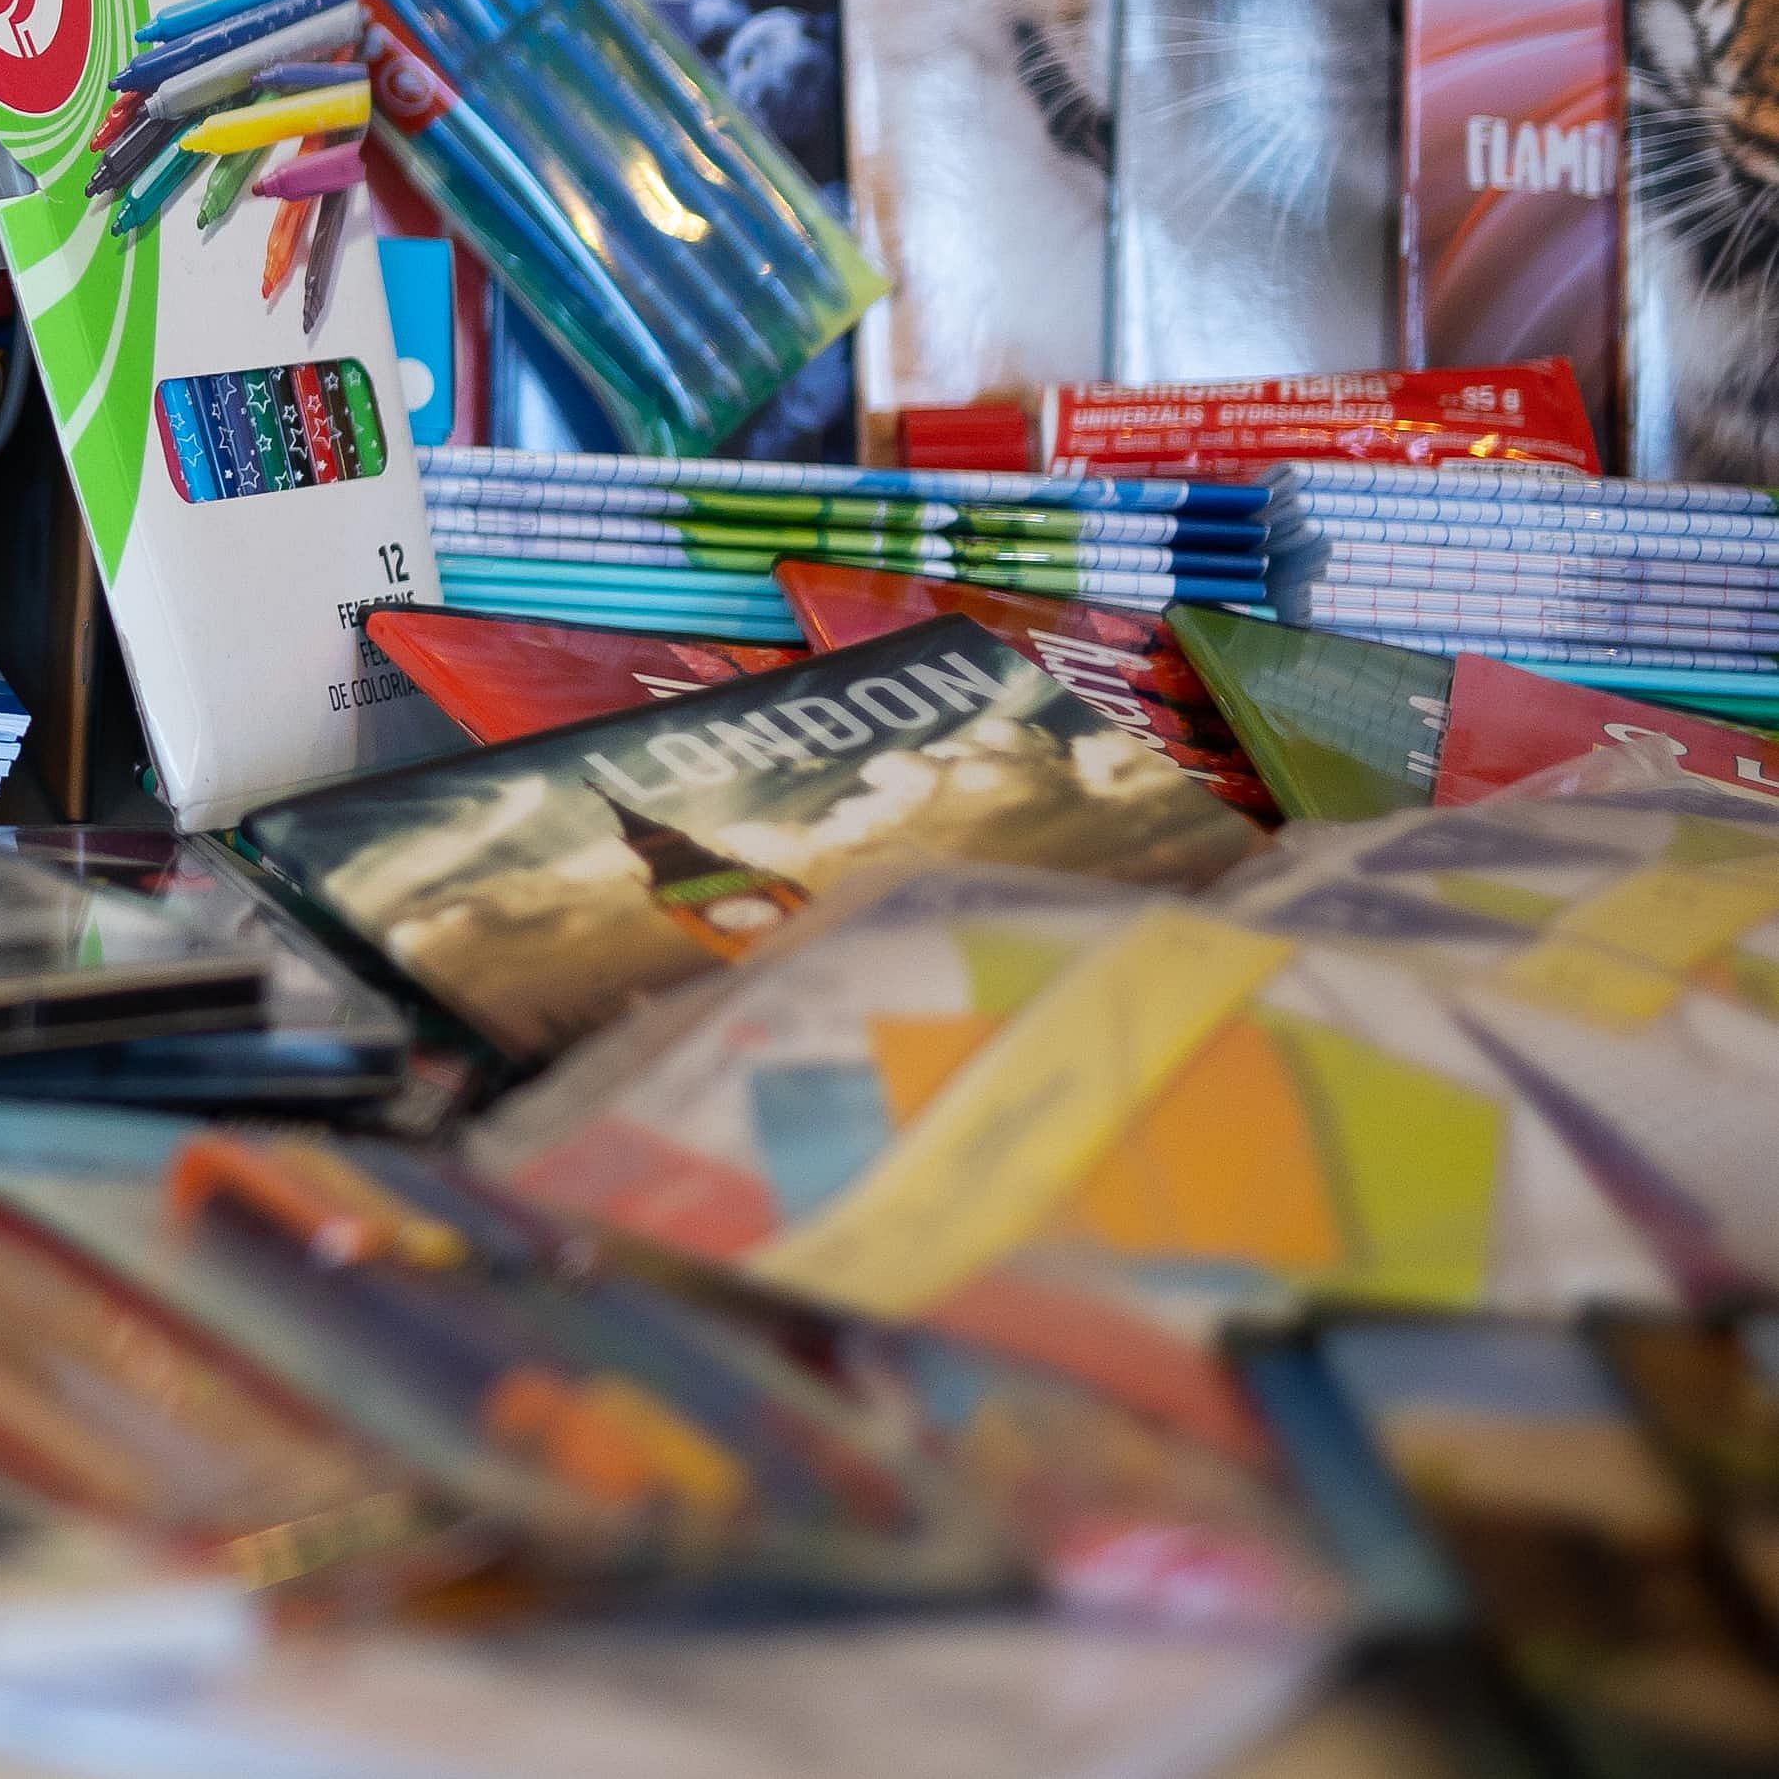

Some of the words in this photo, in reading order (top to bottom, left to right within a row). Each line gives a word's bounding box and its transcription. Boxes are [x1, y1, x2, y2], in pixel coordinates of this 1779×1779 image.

[377, 541, 411, 584] 12
[328, 682, 351, 712] DE
[583, 650, 1010, 804] LONDON
